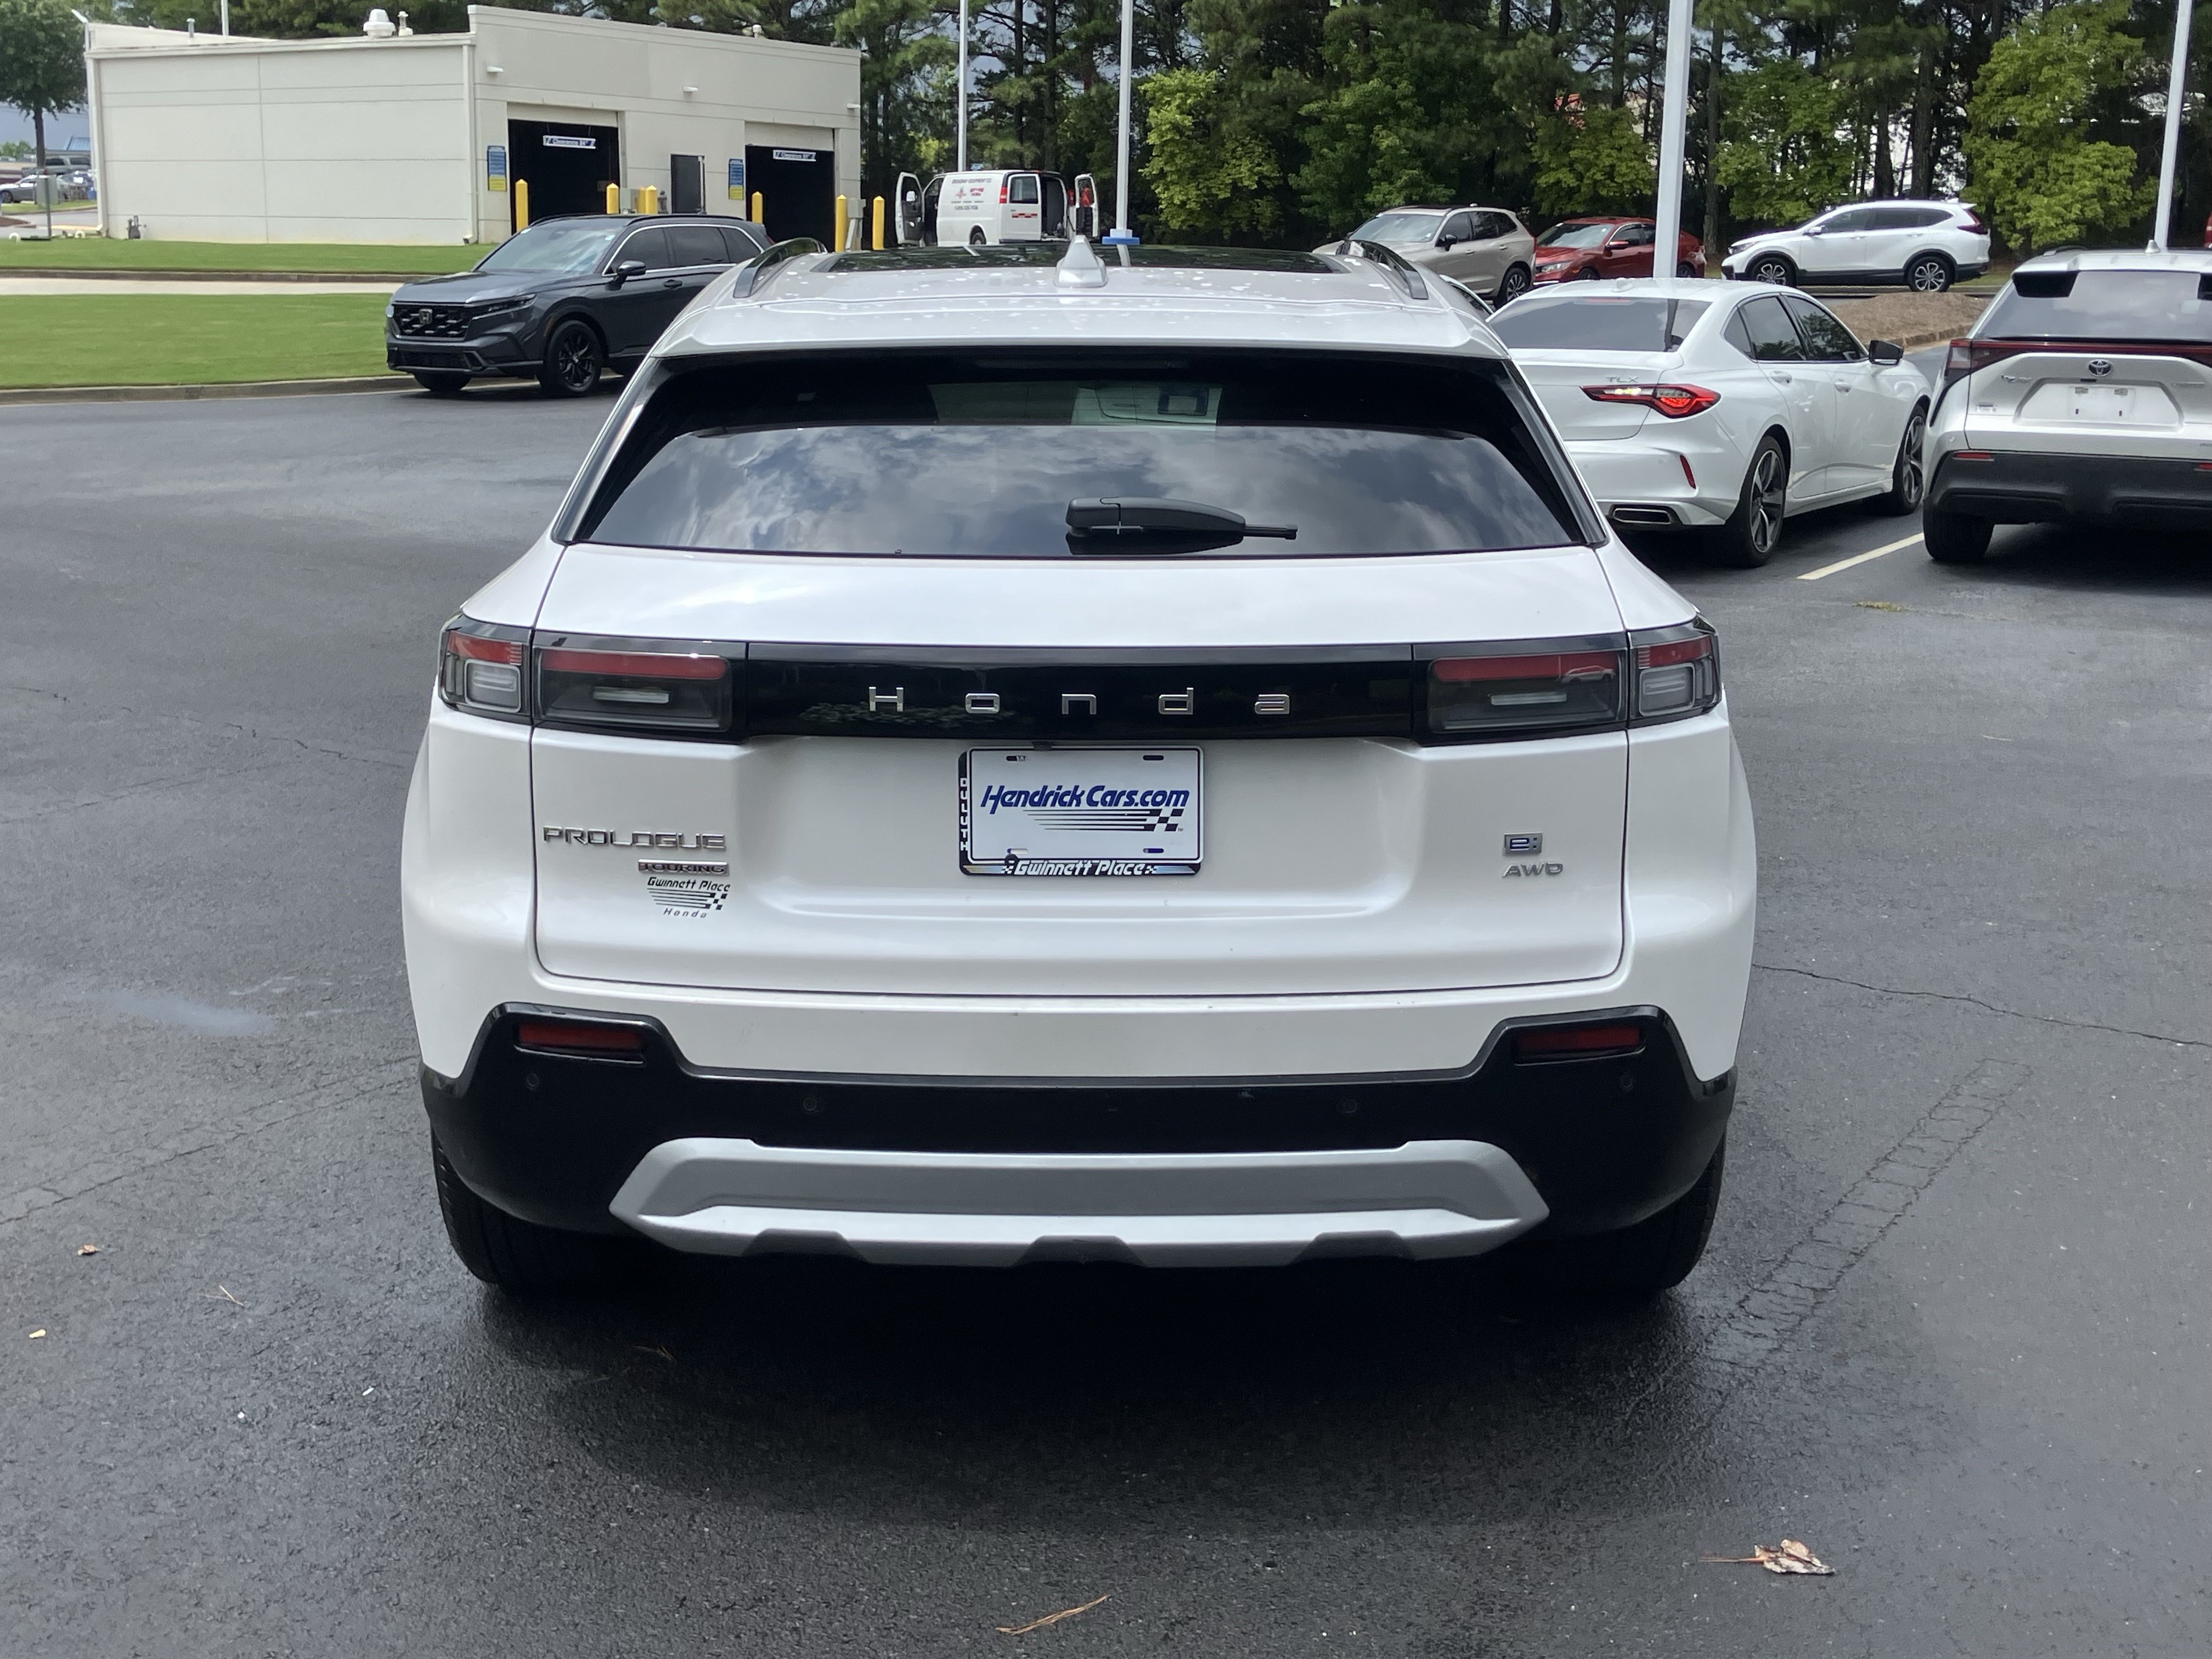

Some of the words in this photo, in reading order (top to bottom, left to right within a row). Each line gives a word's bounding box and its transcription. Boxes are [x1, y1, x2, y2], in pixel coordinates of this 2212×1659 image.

[868, 686, 1290, 714] Honda
[543, 825, 726, 850] PROLOGUE
[639, 863, 725, 873] TOURING
[1014, 860, 1093, 876] Gwinnett
[1094, 860, 1146, 876] Place
[1502, 862, 1564, 878] AWD
[647, 877, 696, 889] Gwinnett
[698, 881, 731, 892] Place
[663, 907, 707, 918] Honda
